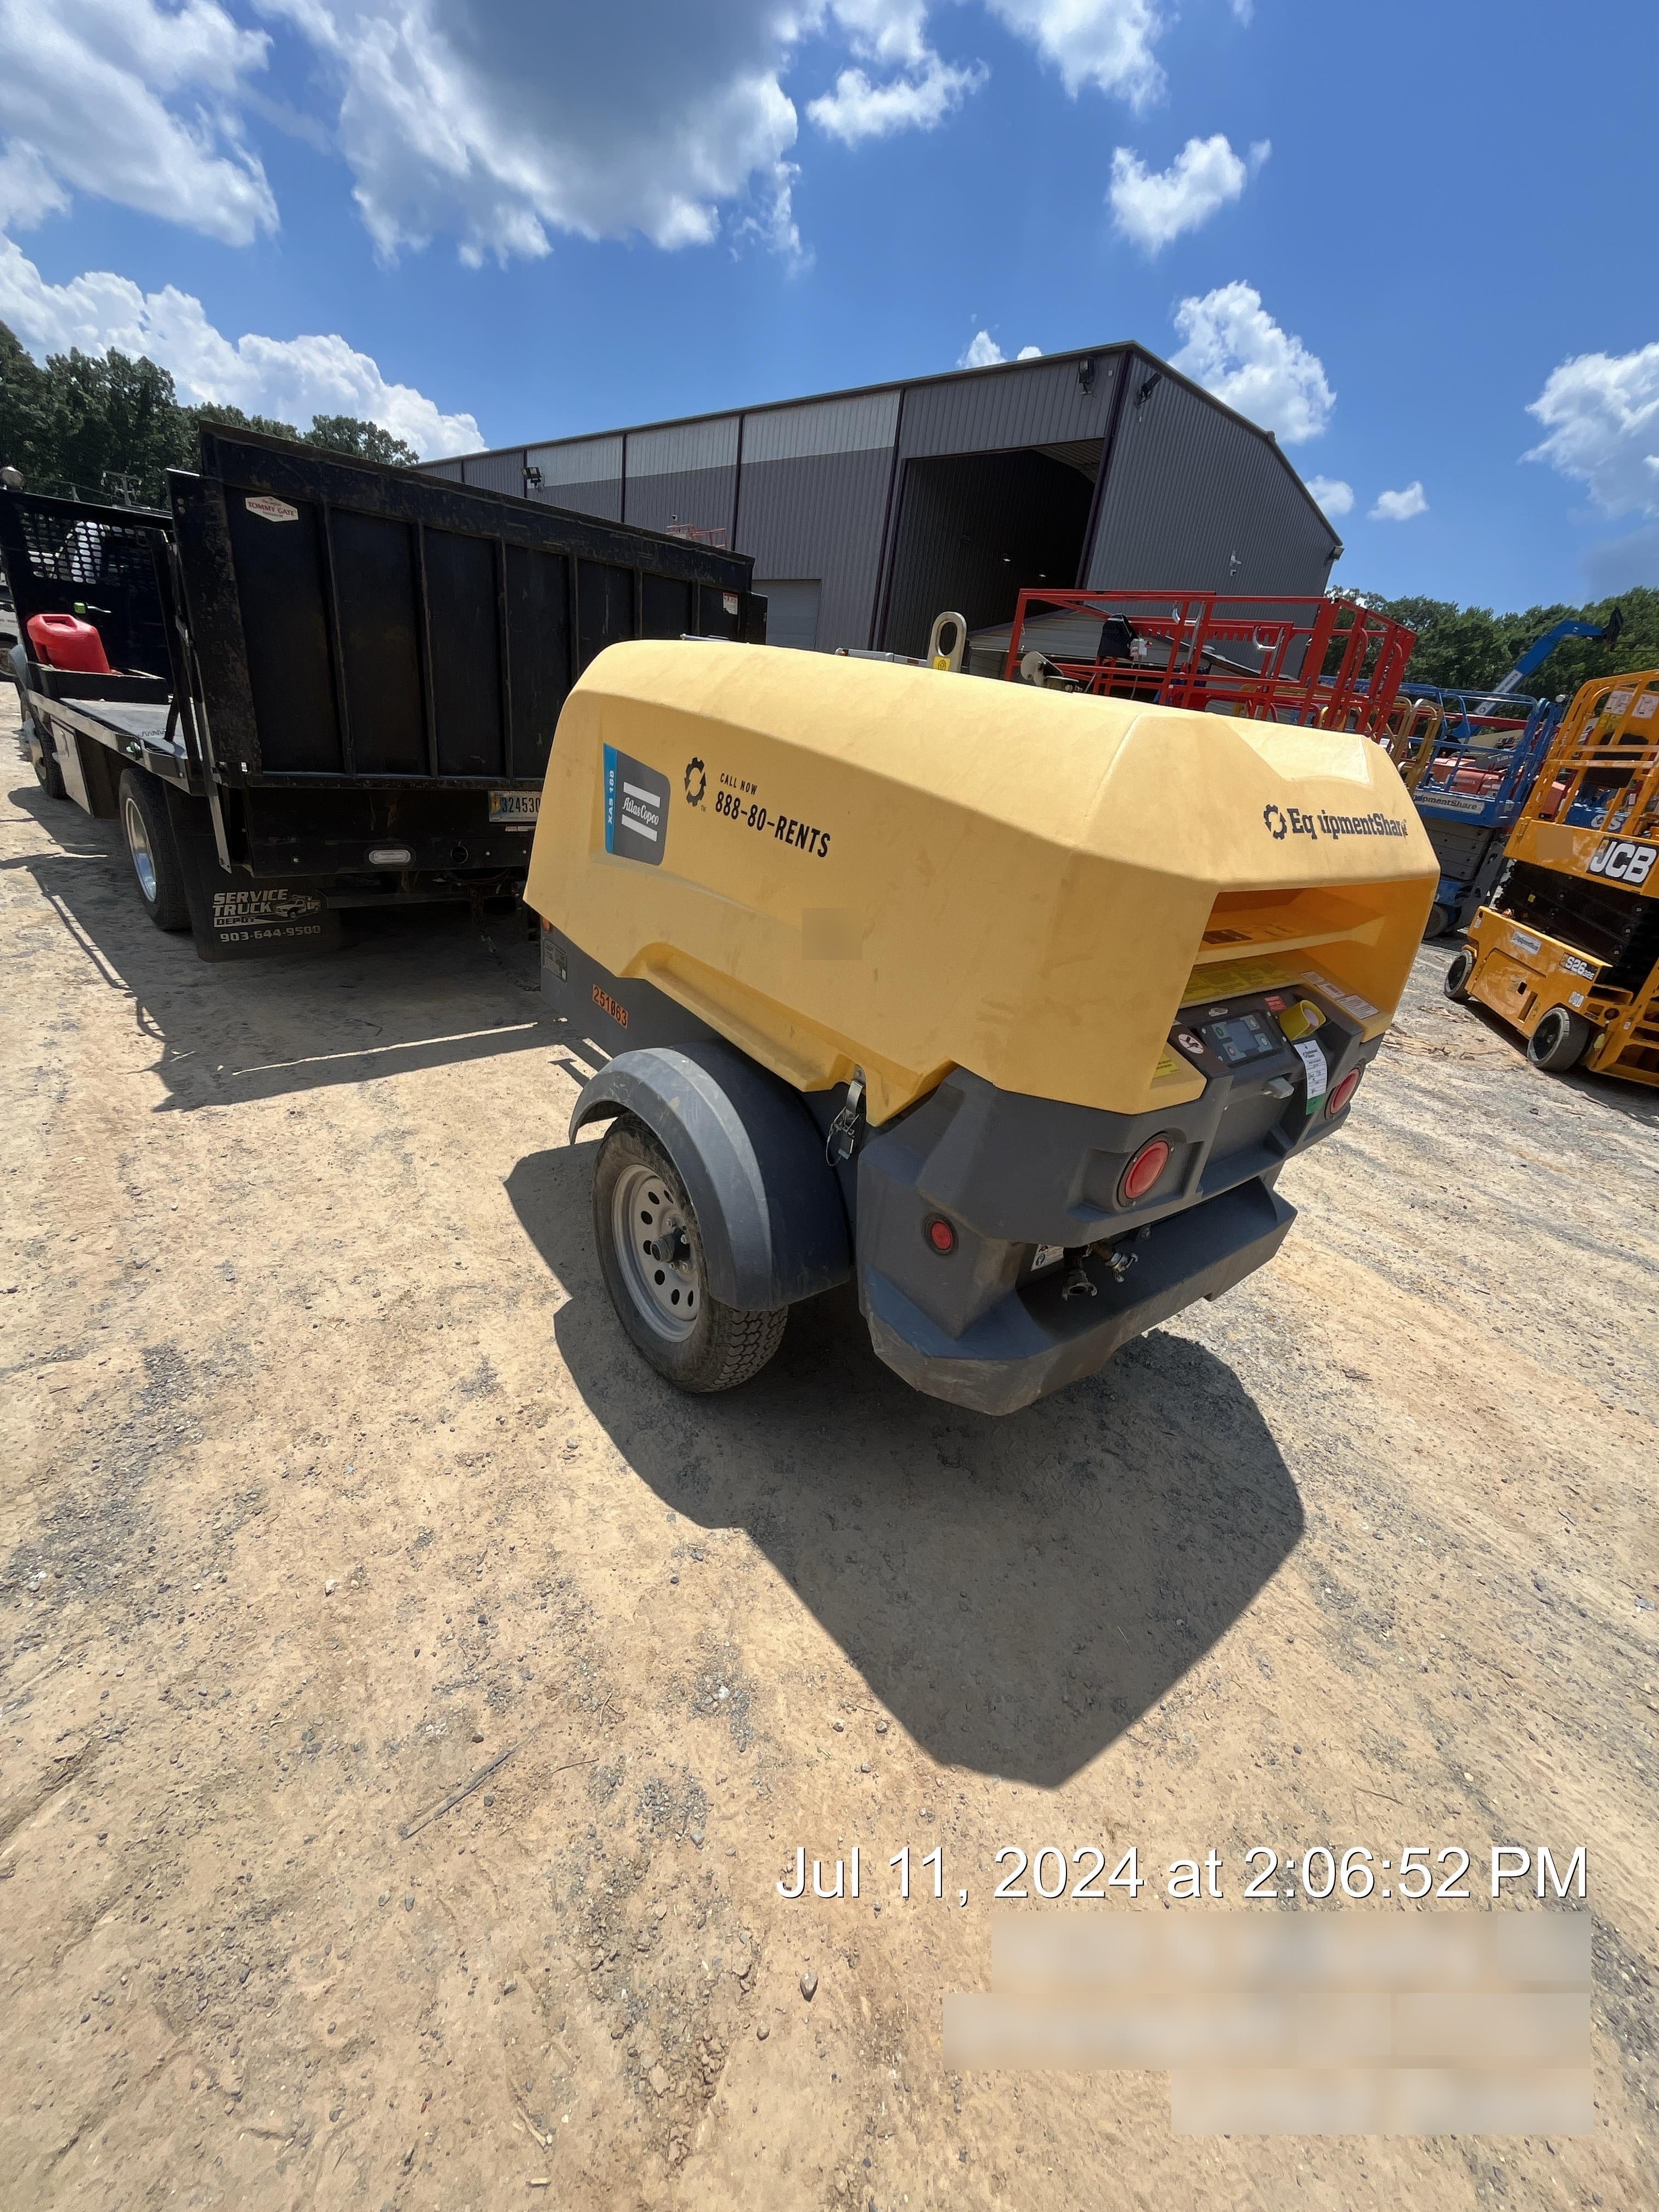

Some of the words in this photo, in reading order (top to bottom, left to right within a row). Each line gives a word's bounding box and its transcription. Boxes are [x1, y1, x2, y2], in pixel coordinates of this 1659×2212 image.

[248, 501, 275, 512] TOMMY
[278, 508, 295, 516] GATE
[720, 773, 737, 788] CALL
[740, 780, 758, 795] NOW
[715, 791, 831, 857] 888-80-RENTS
[1590, 841, 1657, 883] JCB
[213, 889, 289, 905] SERVICE
[213, 901, 273, 917] TRUCK
[216, 916, 255, 926] DEPOT
[220, 926, 321, 942] 903-644-9500
[594, 986, 627, 1026] 251063
